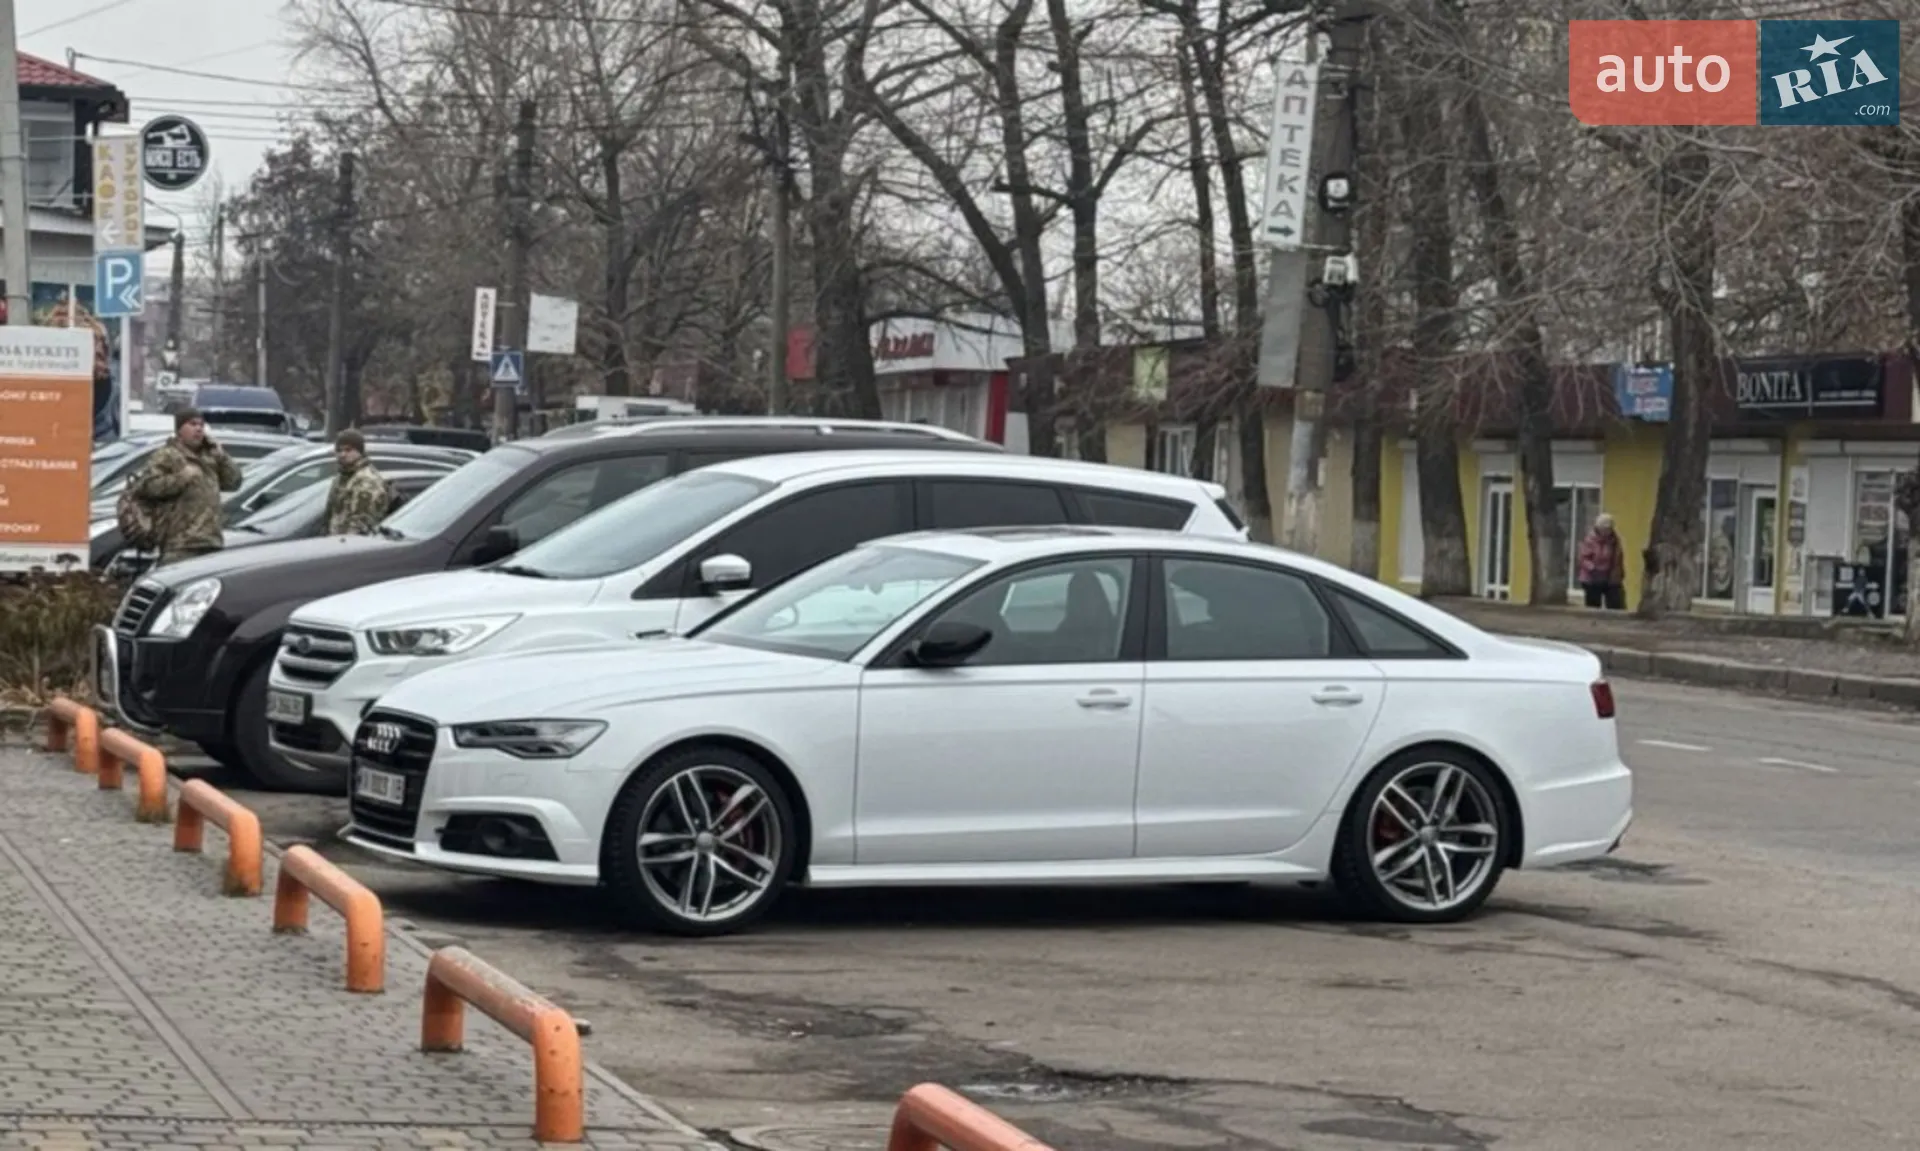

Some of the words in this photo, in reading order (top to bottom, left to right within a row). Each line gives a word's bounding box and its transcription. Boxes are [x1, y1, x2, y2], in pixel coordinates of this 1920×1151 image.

[1270, 69, 1309, 220] АПТЕКА
[98, 144, 116, 219] КАФЕ
[105, 258, 132, 299] P
[25, 346, 79, 358] TICKETS
[1736, 371, 1803, 402] BONITA
